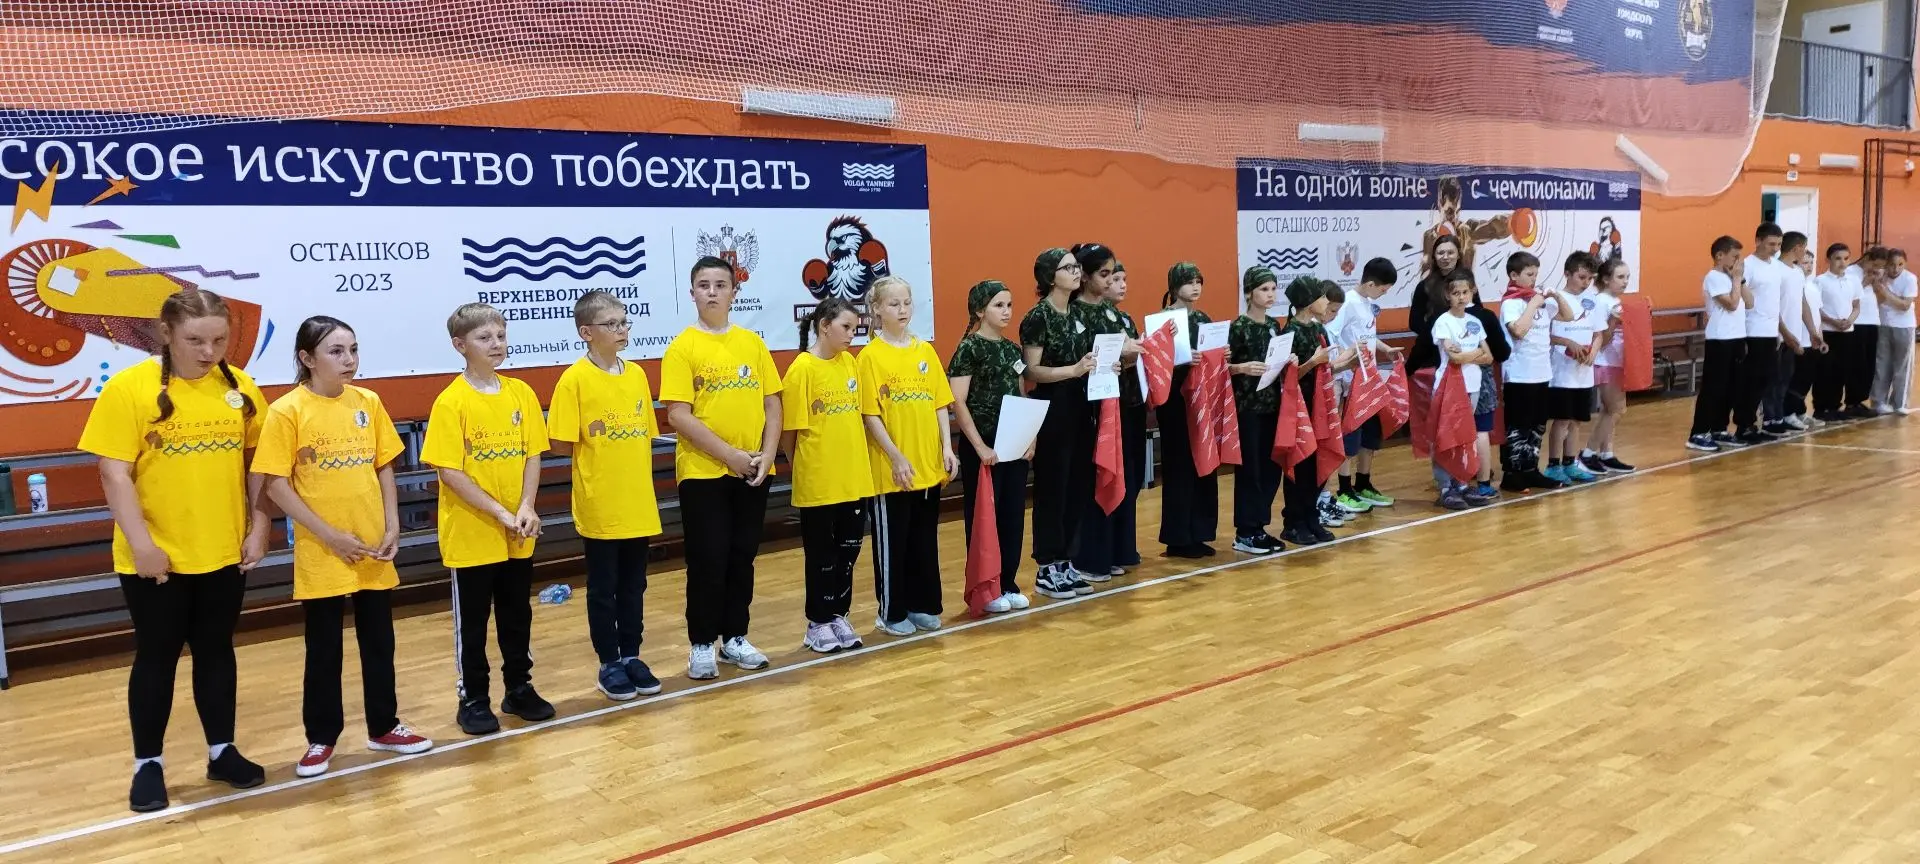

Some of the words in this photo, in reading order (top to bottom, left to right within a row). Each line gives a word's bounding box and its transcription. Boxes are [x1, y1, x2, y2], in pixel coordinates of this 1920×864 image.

[0, 139, 204, 181] сокое
[227, 144, 534, 197] искусство
[551, 142, 811, 196] побеждать
[1255, 167, 1288, 197] На
[1295, 170, 1363, 202] одной
[1369, 177, 1428, 198] волне
[1471, 179, 1480, 199] с
[1488, 179, 1596, 200] чемпионами
[1256, 216, 1328, 233] ОСТАШКОВ
[1332, 217, 1360, 232] 2023
[290, 242, 430, 262] ОСТАШКОВ
[336, 273, 393, 292] 2023
[478, 283, 639, 304] ВЕРХНЕВОЛИЙ
[506, 340, 570, 358] ральный
